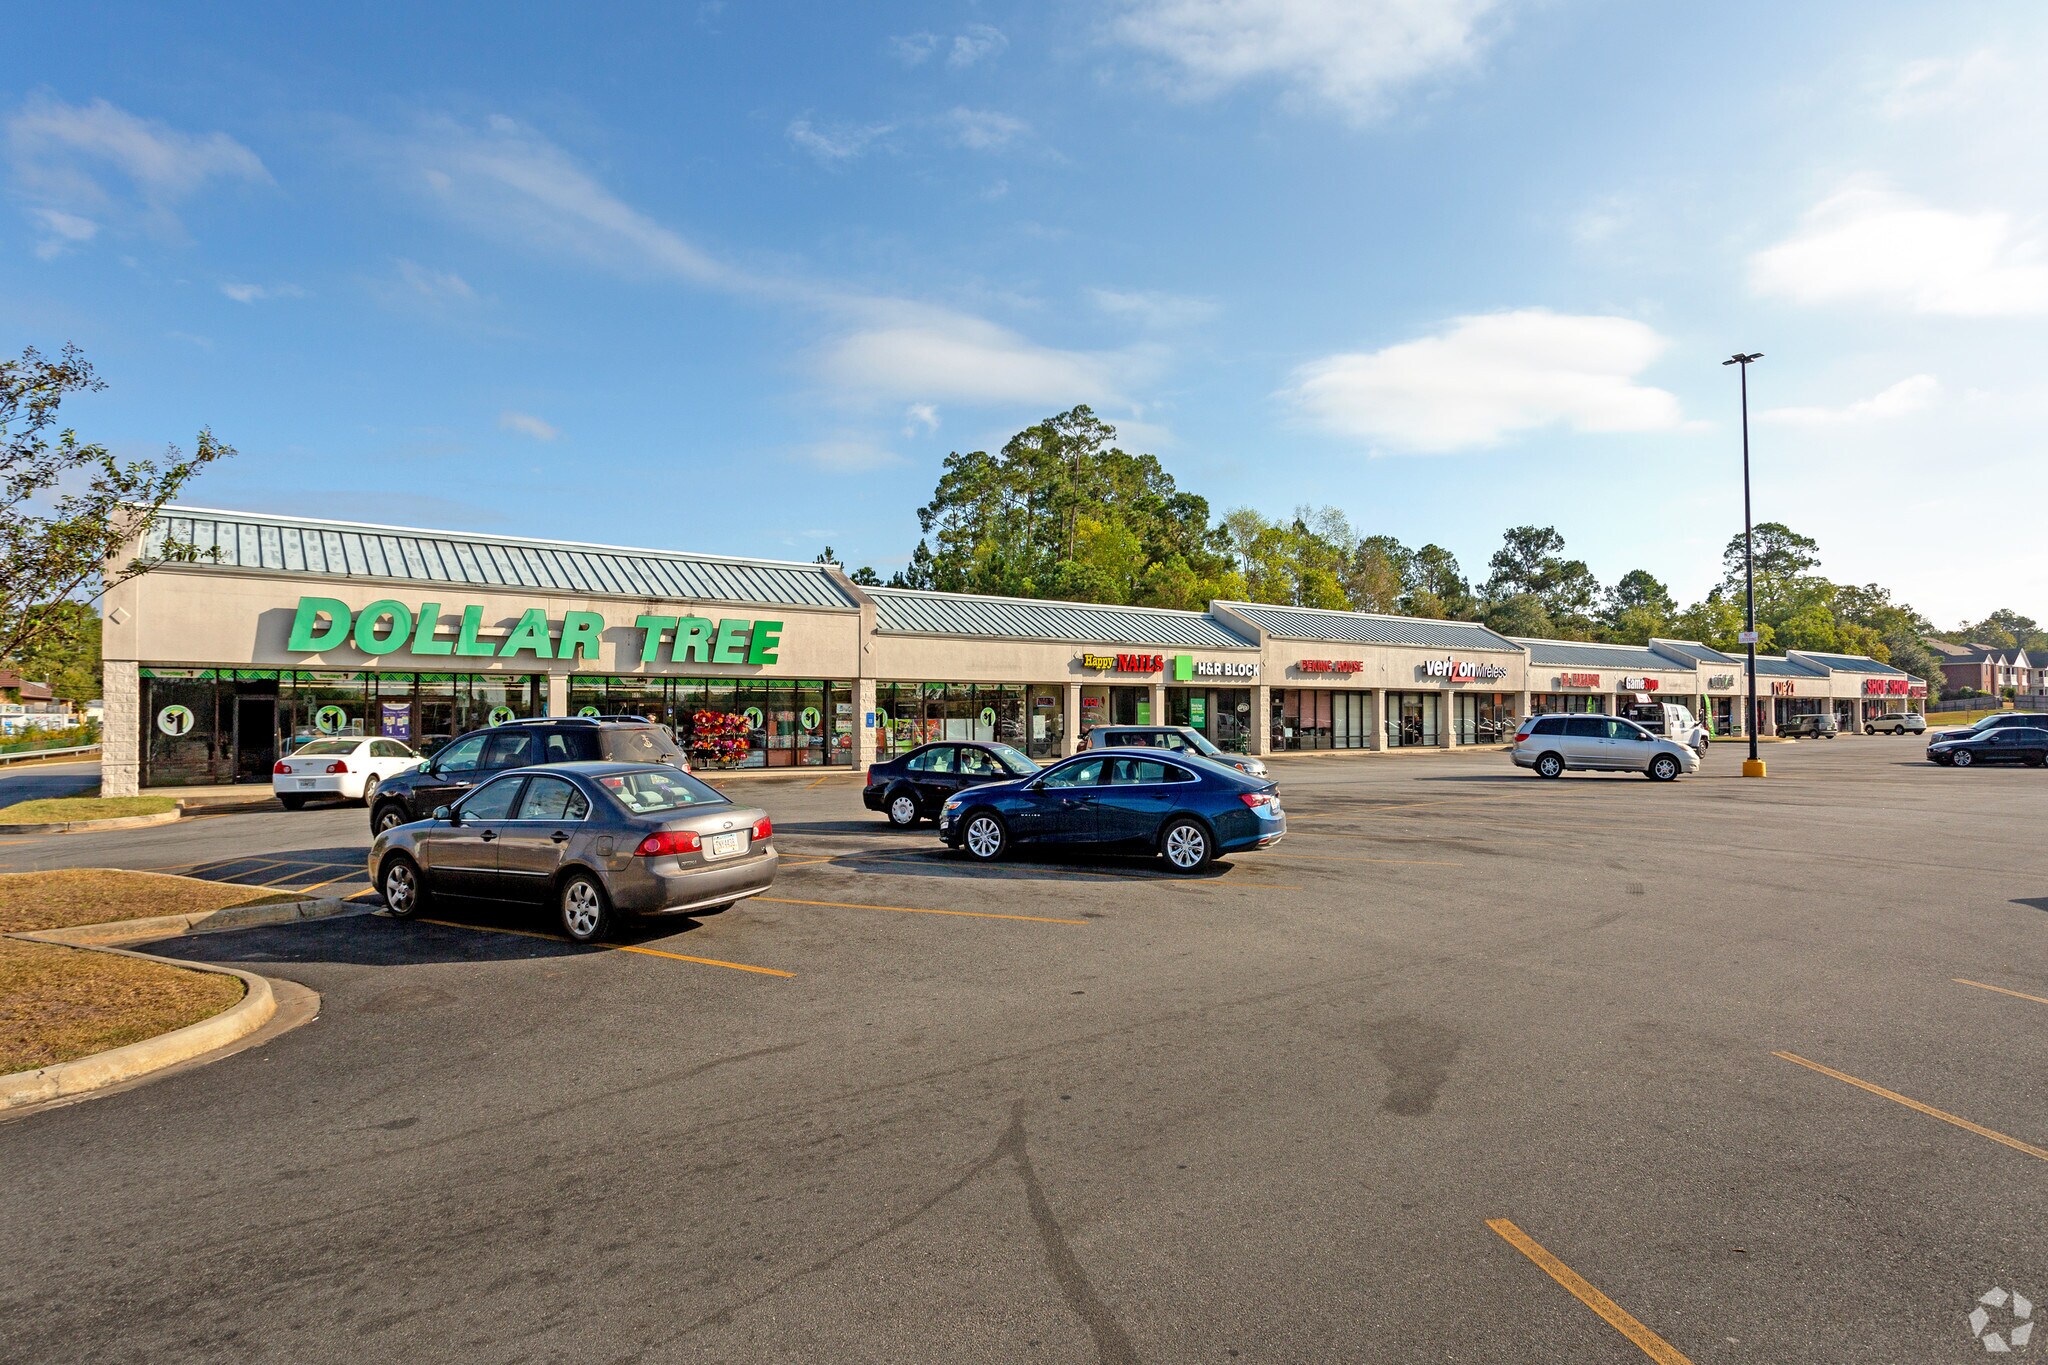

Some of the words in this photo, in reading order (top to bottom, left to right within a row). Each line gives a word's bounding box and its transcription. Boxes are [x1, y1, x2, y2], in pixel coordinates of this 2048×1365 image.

[288, 596, 605, 660] DOLLAR
[635, 615, 784, 665] TREE
[1084, 654, 1115, 670] Happy
[1117, 654, 1165, 672] NAILS
[1198, 662, 1222, 676] H&R
[1224, 663, 1260, 677] BLOCK
[1301, 660, 1333, 672] PEKING
[1336, 661, 1364, 673] HOUSE
[1425, 656, 1476, 682] verizon
[1475, 663, 1508, 679] wireless
[1625, 677, 1659, 691] GameStop
[1867, 679, 1887, 695] SHOE
[1888, 680, 1909, 695] SHOW
[166, 712, 185, 735] $1
[322, 711, 339, 733] $1
[805, 712, 816, 729] $1
[983, 712, 992, 727] $1
